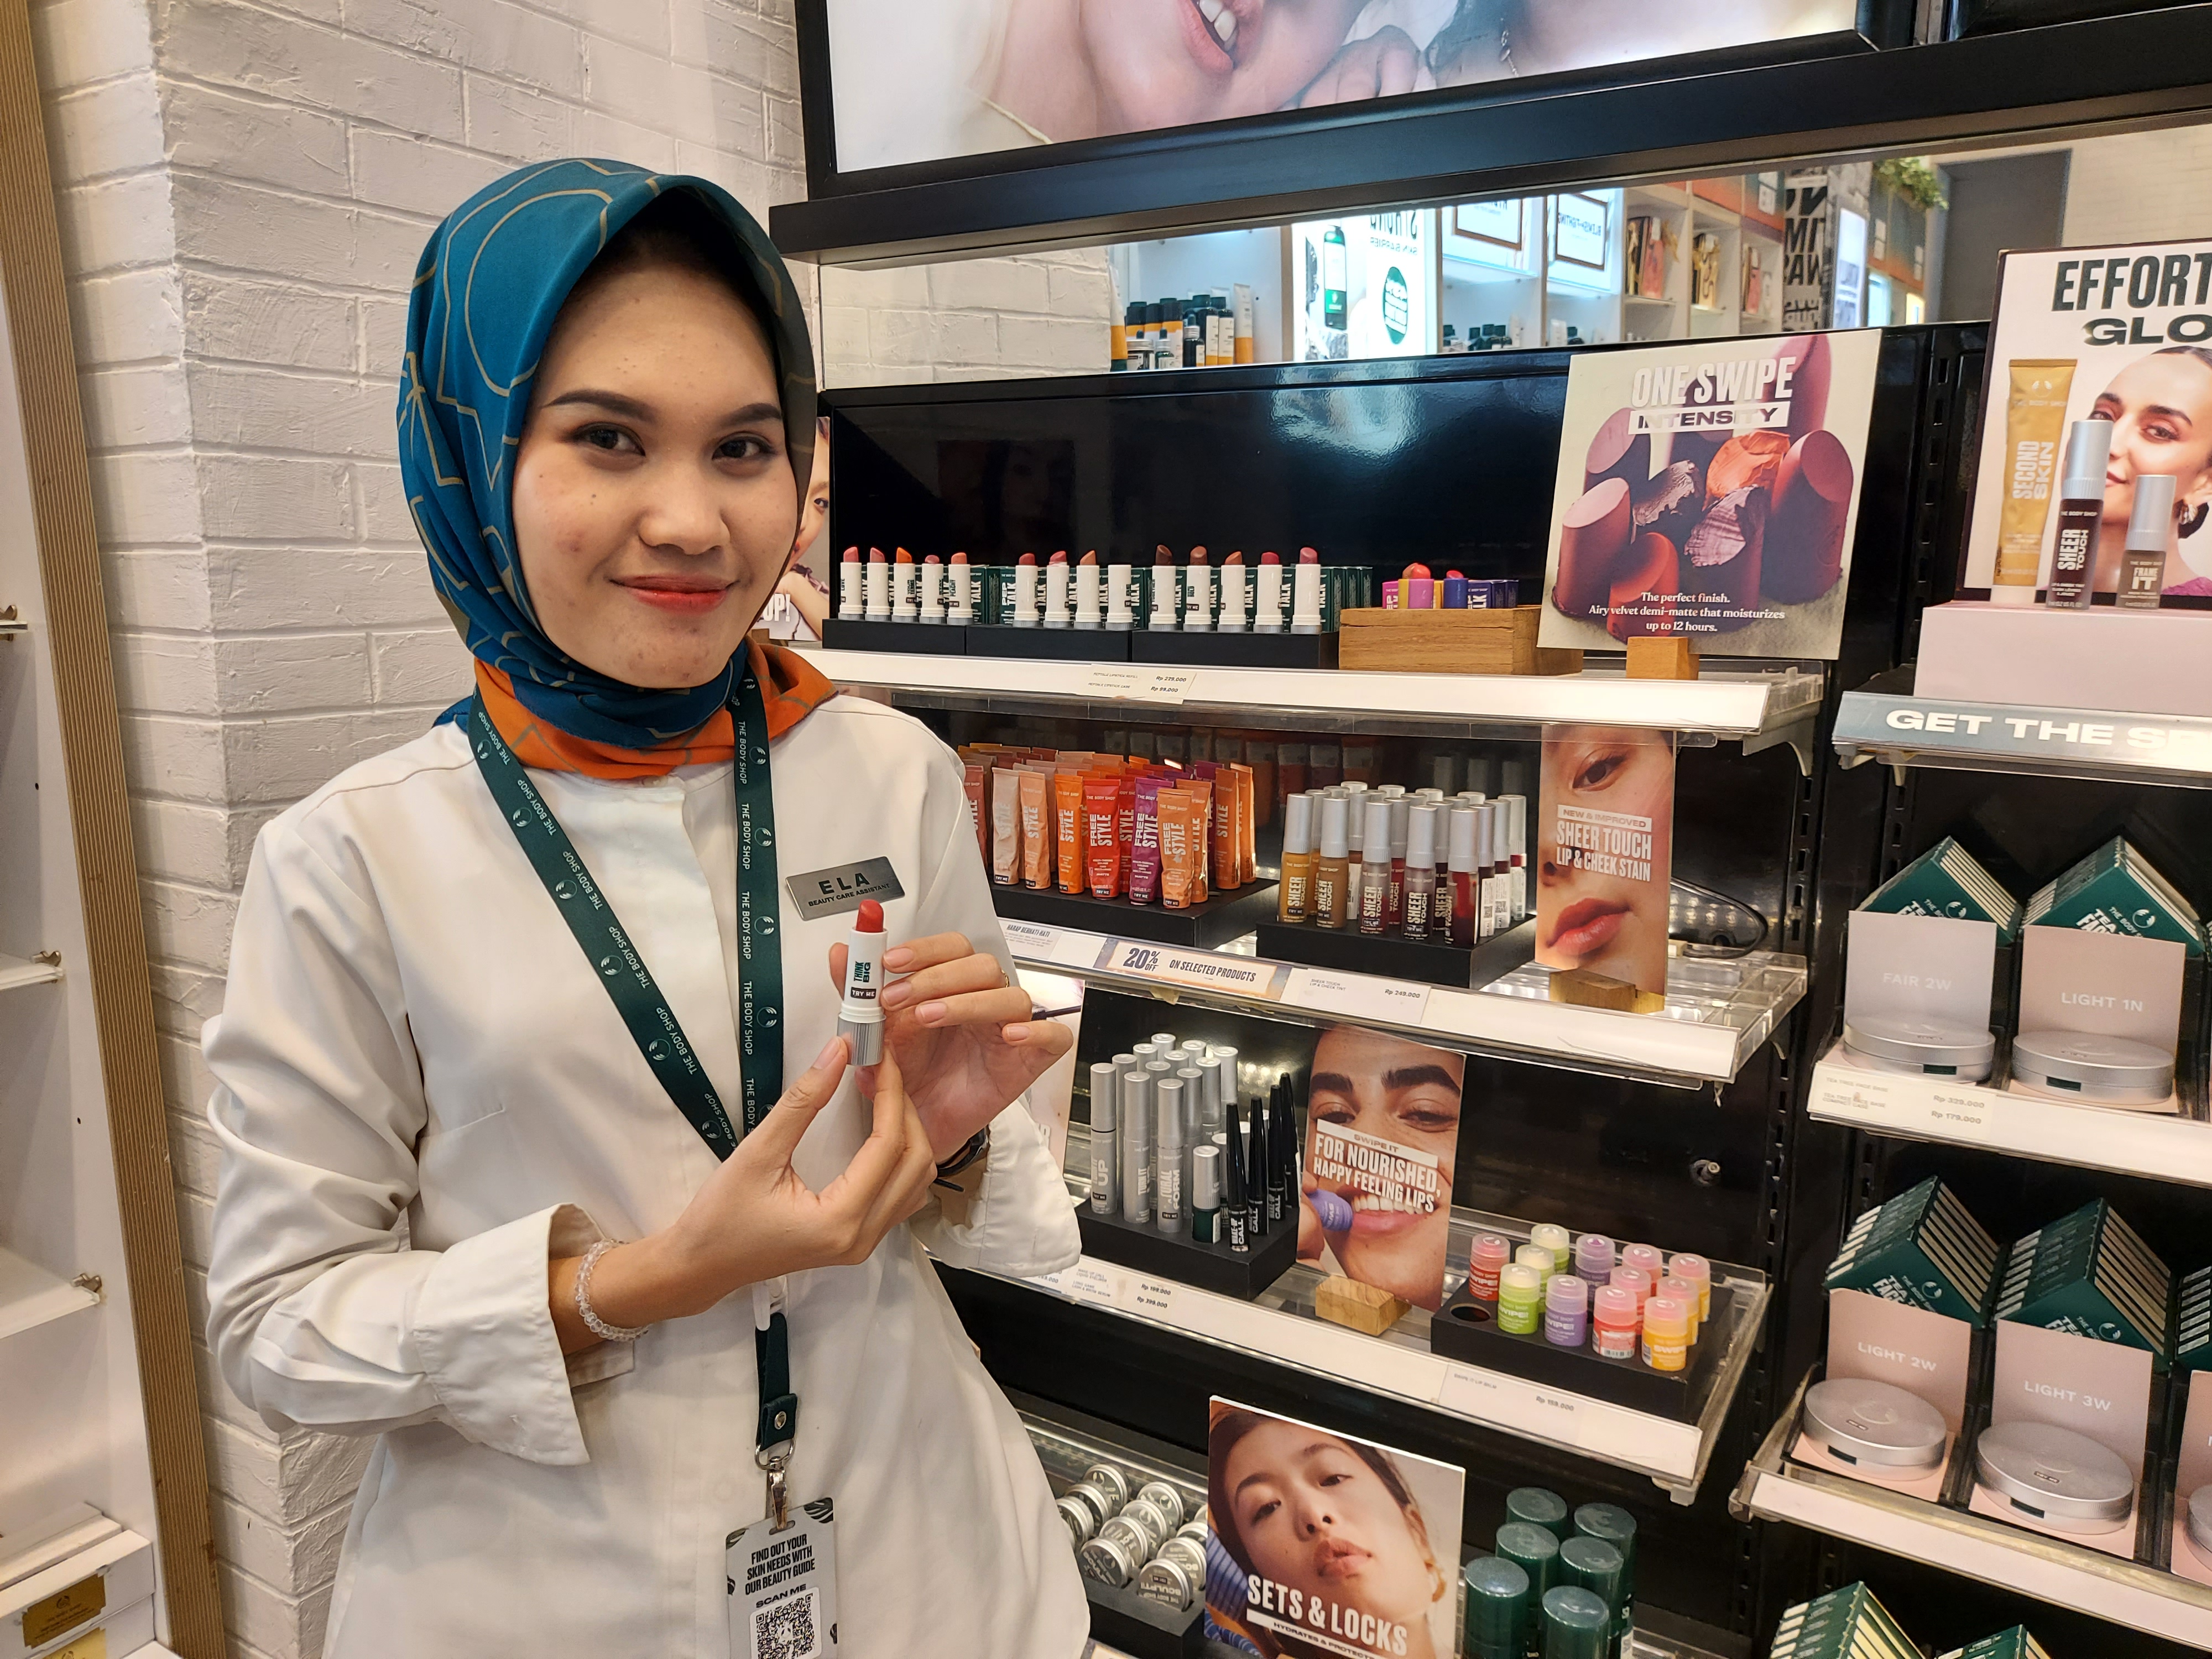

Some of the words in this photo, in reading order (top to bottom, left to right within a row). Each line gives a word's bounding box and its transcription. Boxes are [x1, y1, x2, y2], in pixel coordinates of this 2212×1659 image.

[1631, 365, 1689, 408] ONE
[1693, 357, 1797, 403] SWIPE
[2012, 441, 2040, 499] SECOND
[2033, 442, 2054, 499] SKIN
[2057, 529, 2081, 570] SHEER
[2075, 530, 2089, 570] TOUCH
[2132, 577, 2157, 590] IT
[2133, 567, 2158, 577] FRAME
[971, 581, 981, 603] TALK
[1006, 582, 1016, 606] TALK
[1641, 592, 1659, 602] The
[1660, 594, 1696, 604] perfect
[1698, 593, 1730, 603] finish.
[1589, 606, 1609, 617] Airy
[1610, 607, 1639, 615] velvet
[1640, 608, 1698, 617] demi-matte
[1699, 608, 1721, 617] that
[1723, 609, 1786, 619] moisturizes
[1646, 622, 1658, 632] up
[1660, 622, 1671, 630] to
[1673, 622, 1684, 630] 12
[1686, 622, 1718, 632] hours.
[478, 711, 491, 732] SHOP
[738, 721, 747, 737] THE
[1886, 709, 1992, 735] GET
[2005, 717, 2114, 745] THE
[488, 730, 502, 751] BODY
[499, 750, 511, 765] THE
[518, 779, 534, 800] SHOP
[530, 800, 547, 821] BODY
[742, 803, 750, 819] THE
[1563, 809, 1584, 818] NEW
[1595, 814, 1646, 828] IMPROVED
[543, 819, 556, 836] THE
[742, 822, 751, 845] BODY
[1064, 810, 1074, 843] STYLE
[1097, 814, 1112, 847] STYLE
[1134, 813, 1144, 847] FREE
[1142, 814, 1158, 848] STYLE
[1163, 823, 1172, 855] FREE
[1171, 823, 1186, 855] STYLE
[1556, 820, 1599, 851] SHEER
[1603, 828, 1652, 860] TOUCH
[562, 851, 580, 873] SHOP
[743, 846, 751, 870] SHOP
[1556, 847, 1572, 866] LIP
[1573, 850, 1582, 869] &
[1584, 852, 1618, 875] CHEEK
[1619, 858, 1651, 881] STAIN
[576, 872, 593, 894] BODY
[818, 873, 870, 895] ELA
[1287, 877, 1302, 906] SHEER
[589, 894, 603, 911] THE
[742, 891, 750, 909] THE
[808, 896, 835, 907] BEAUTY
[836, 892, 855, 900] CARE
[856, 883, 890, 896] ASSISTANT
[1318, 880, 1328, 911] SHEER
[1363, 886, 1377, 917] SHEER
[1407, 892, 1422, 924] SHEER
[2094, 908, 2116, 931] TEA
[742, 911, 750, 935] BODY
[609, 926, 627, 949] SHOP
[743, 936, 751, 960] SHOP
[622, 948, 640, 971] BODY
[854, 961, 864, 981] THINK
[1144, 963, 1159, 972] OFF
[1170, 959, 1180, 969] ON
[1180, 961, 1215, 976] SELECTED
[1216, 967, 1256, 982] PRODUCTS
[636, 971, 650, 989] THE
[863, 962, 871, 983] BIG
[1883, 972, 1919, 988] FAIR
[744, 981, 753, 999] THE
[744, 1001, 753, 1027] BODY
[2061, 992, 2116, 1008] LIGHT
[2123, 999, 2143, 1013] 1N
[656, 1007, 675, 1031] SHOP
[669, 1031, 688, 1056] BODY
[745, 1029, 753, 1055] SHOP
[683, 1056, 698, 1075] THE
[746, 1078, 755, 1097] THE
[704, 1093, 722, 1116] SHOP
[747, 1099, 755, 1125] BODY
[1931, 1110, 1943, 1119] Rp
[1354, 1134, 1387, 1149] SWIPE
[1389, 1145, 1399, 1153] IT
[1098, 1159, 1108, 1186] UP
[1314, 1133, 1345, 1164] FOR
[1347, 1144, 1441, 1198] NOURISHED,
[1313, 1156, 1353, 1186] HAPPY
[1354, 1171, 1404, 1203] FEELING
[1406, 1187, 1434, 1213] LIPS
[1888, 1275, 1907, 1299] TEA
[2077, 1316, 2089, 1329] THE
[1857, 1342, 1906, 1363] LIGHT
[1911, 1356, 1937, 1373] 2W
[1536, 1395, 1545, 1404] Rp
[2024, 1380, 2077, 1402] LIGHT
[2082, 1395, 2111, 1412] 3W
[752, 1547, 769, 1564] FIND
[770, 1541, 786, 1557] OUT
[786, 1533, 807, 1551] YOUR
[747, 1562, 765, 1580] SKIN
[766, 1553, 791, 1573] NEEDS
[792, 1545, 812, 1563] WITH
[745, 1579, 761, 1595] OUR
[763, 1567, 791, 1589] BEAUTY
[793, 1558, 815, 1577] GUIDE
[756, 1590, 787, 1608] SCAN
[790, 1584, 806, 1596] ME
[1247, 1574, 1303, 1620] SETS
[1308, 1595, 1326, 1629] &
[1331, 1603, 1407, 1656] LOCKS
[1274, 1622, 1319, 1642] HYDRATES
